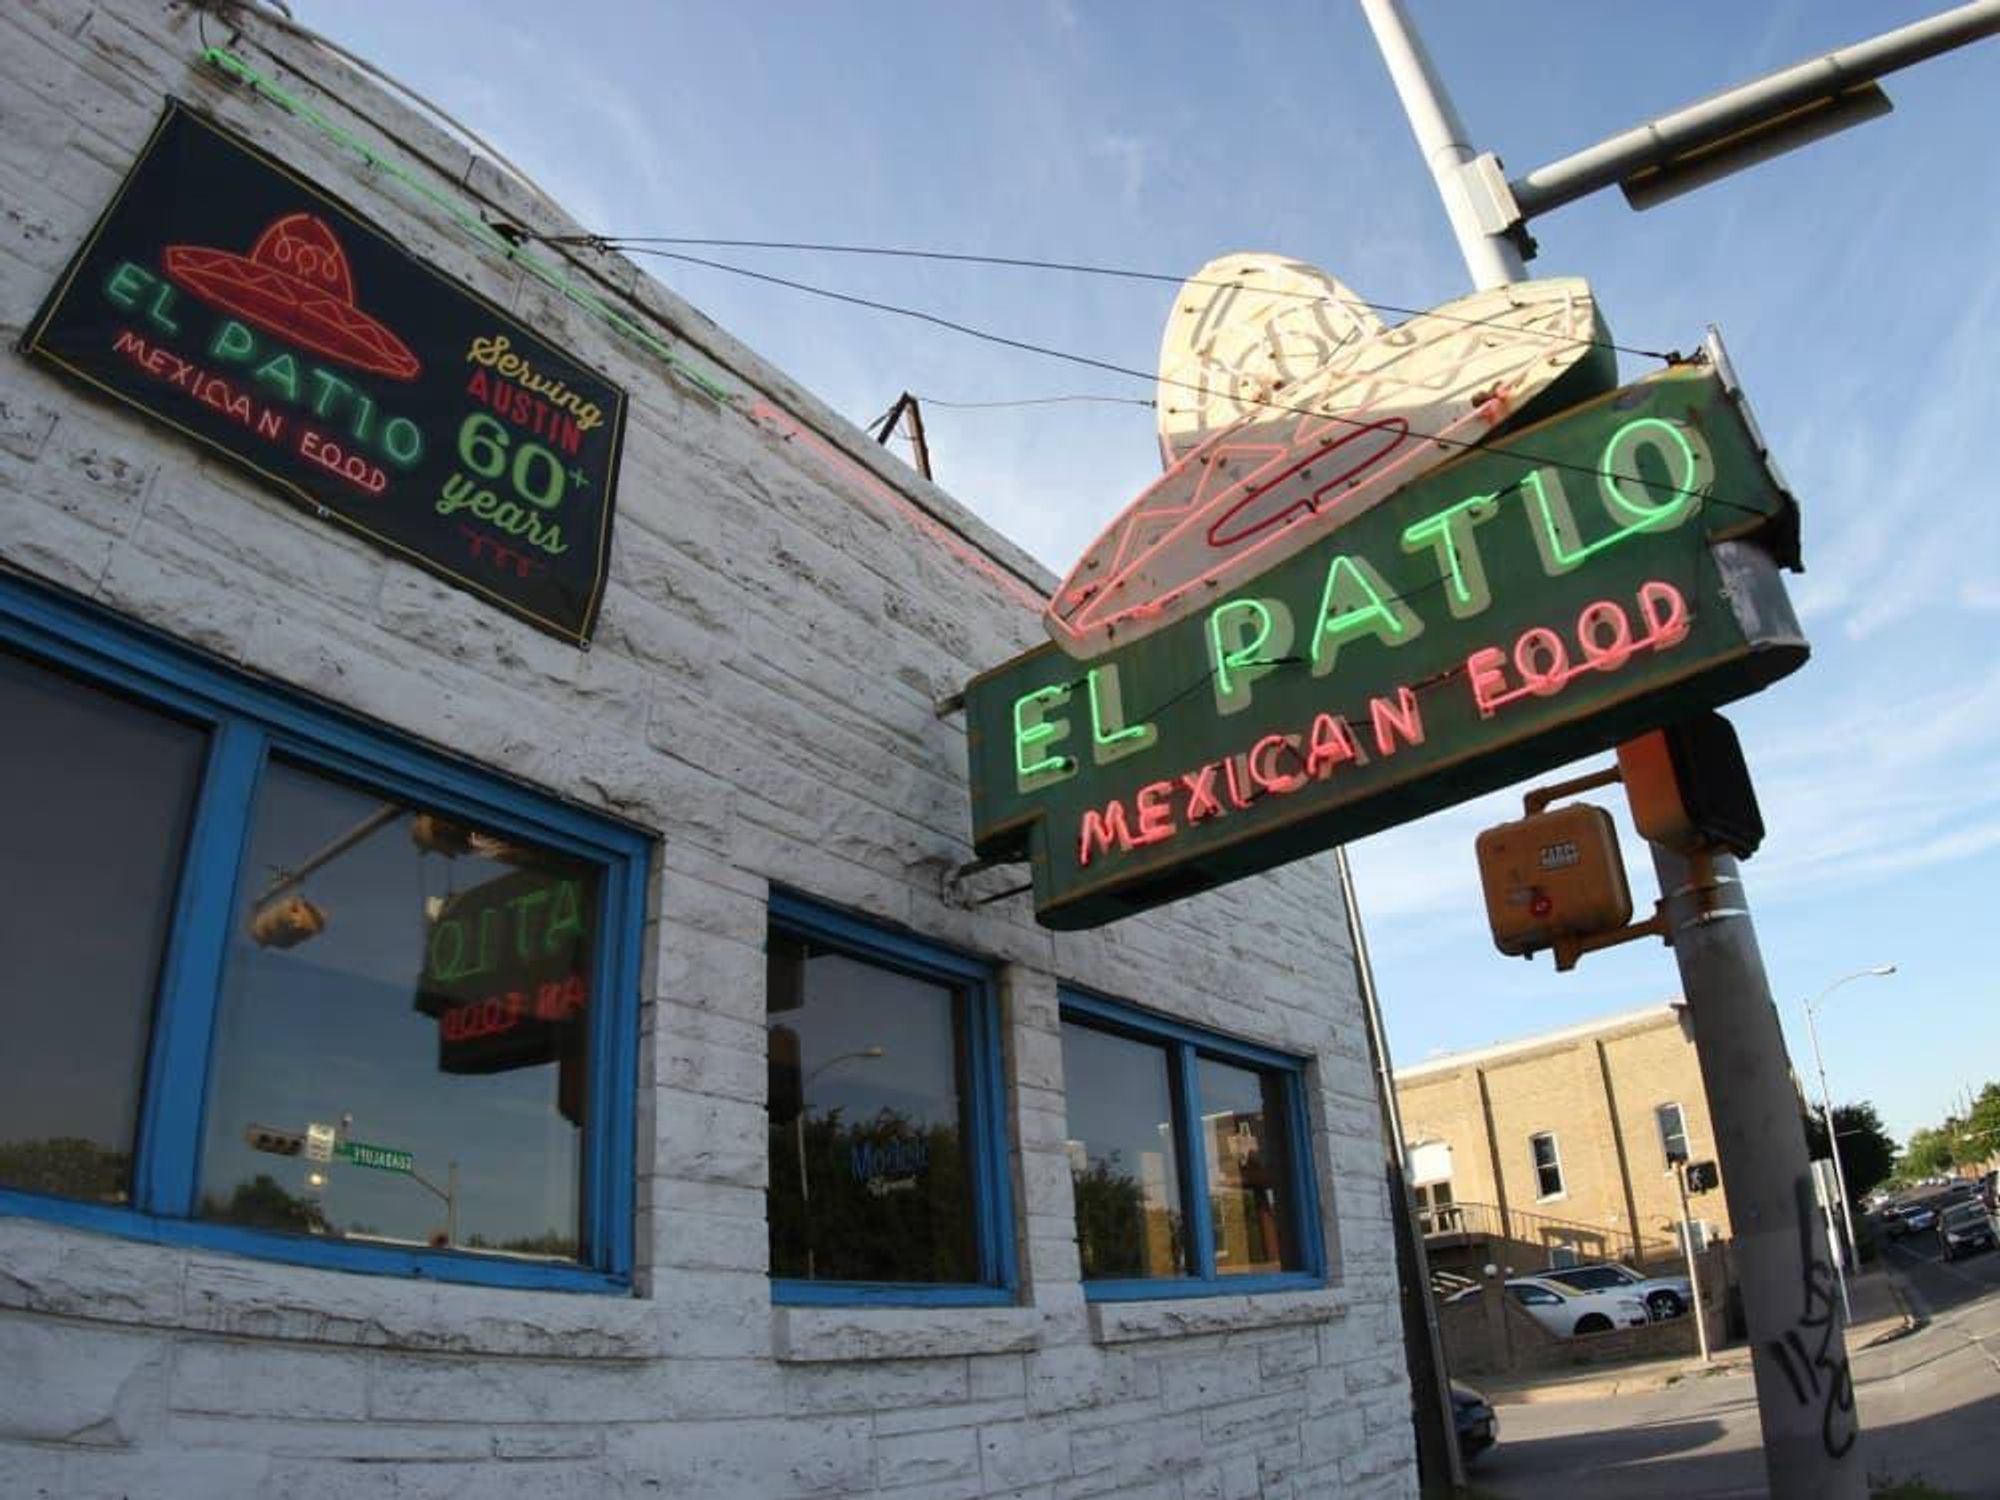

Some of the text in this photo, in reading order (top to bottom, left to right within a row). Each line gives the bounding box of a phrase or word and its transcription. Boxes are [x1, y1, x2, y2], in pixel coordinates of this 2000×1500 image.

[108, 262, 421, 461] EL PATIO
[112, 331, 387, 493] MEXICAN FOOD
[466, 335, 604, 431] Serving
[467, 367, 584, 457] AUSTIN
[435, 472, 569, 554] years
[1014, 417, 1715, 794] EL PATIO
[1077, 581, 1691, 867] MEXICAN FOOD
